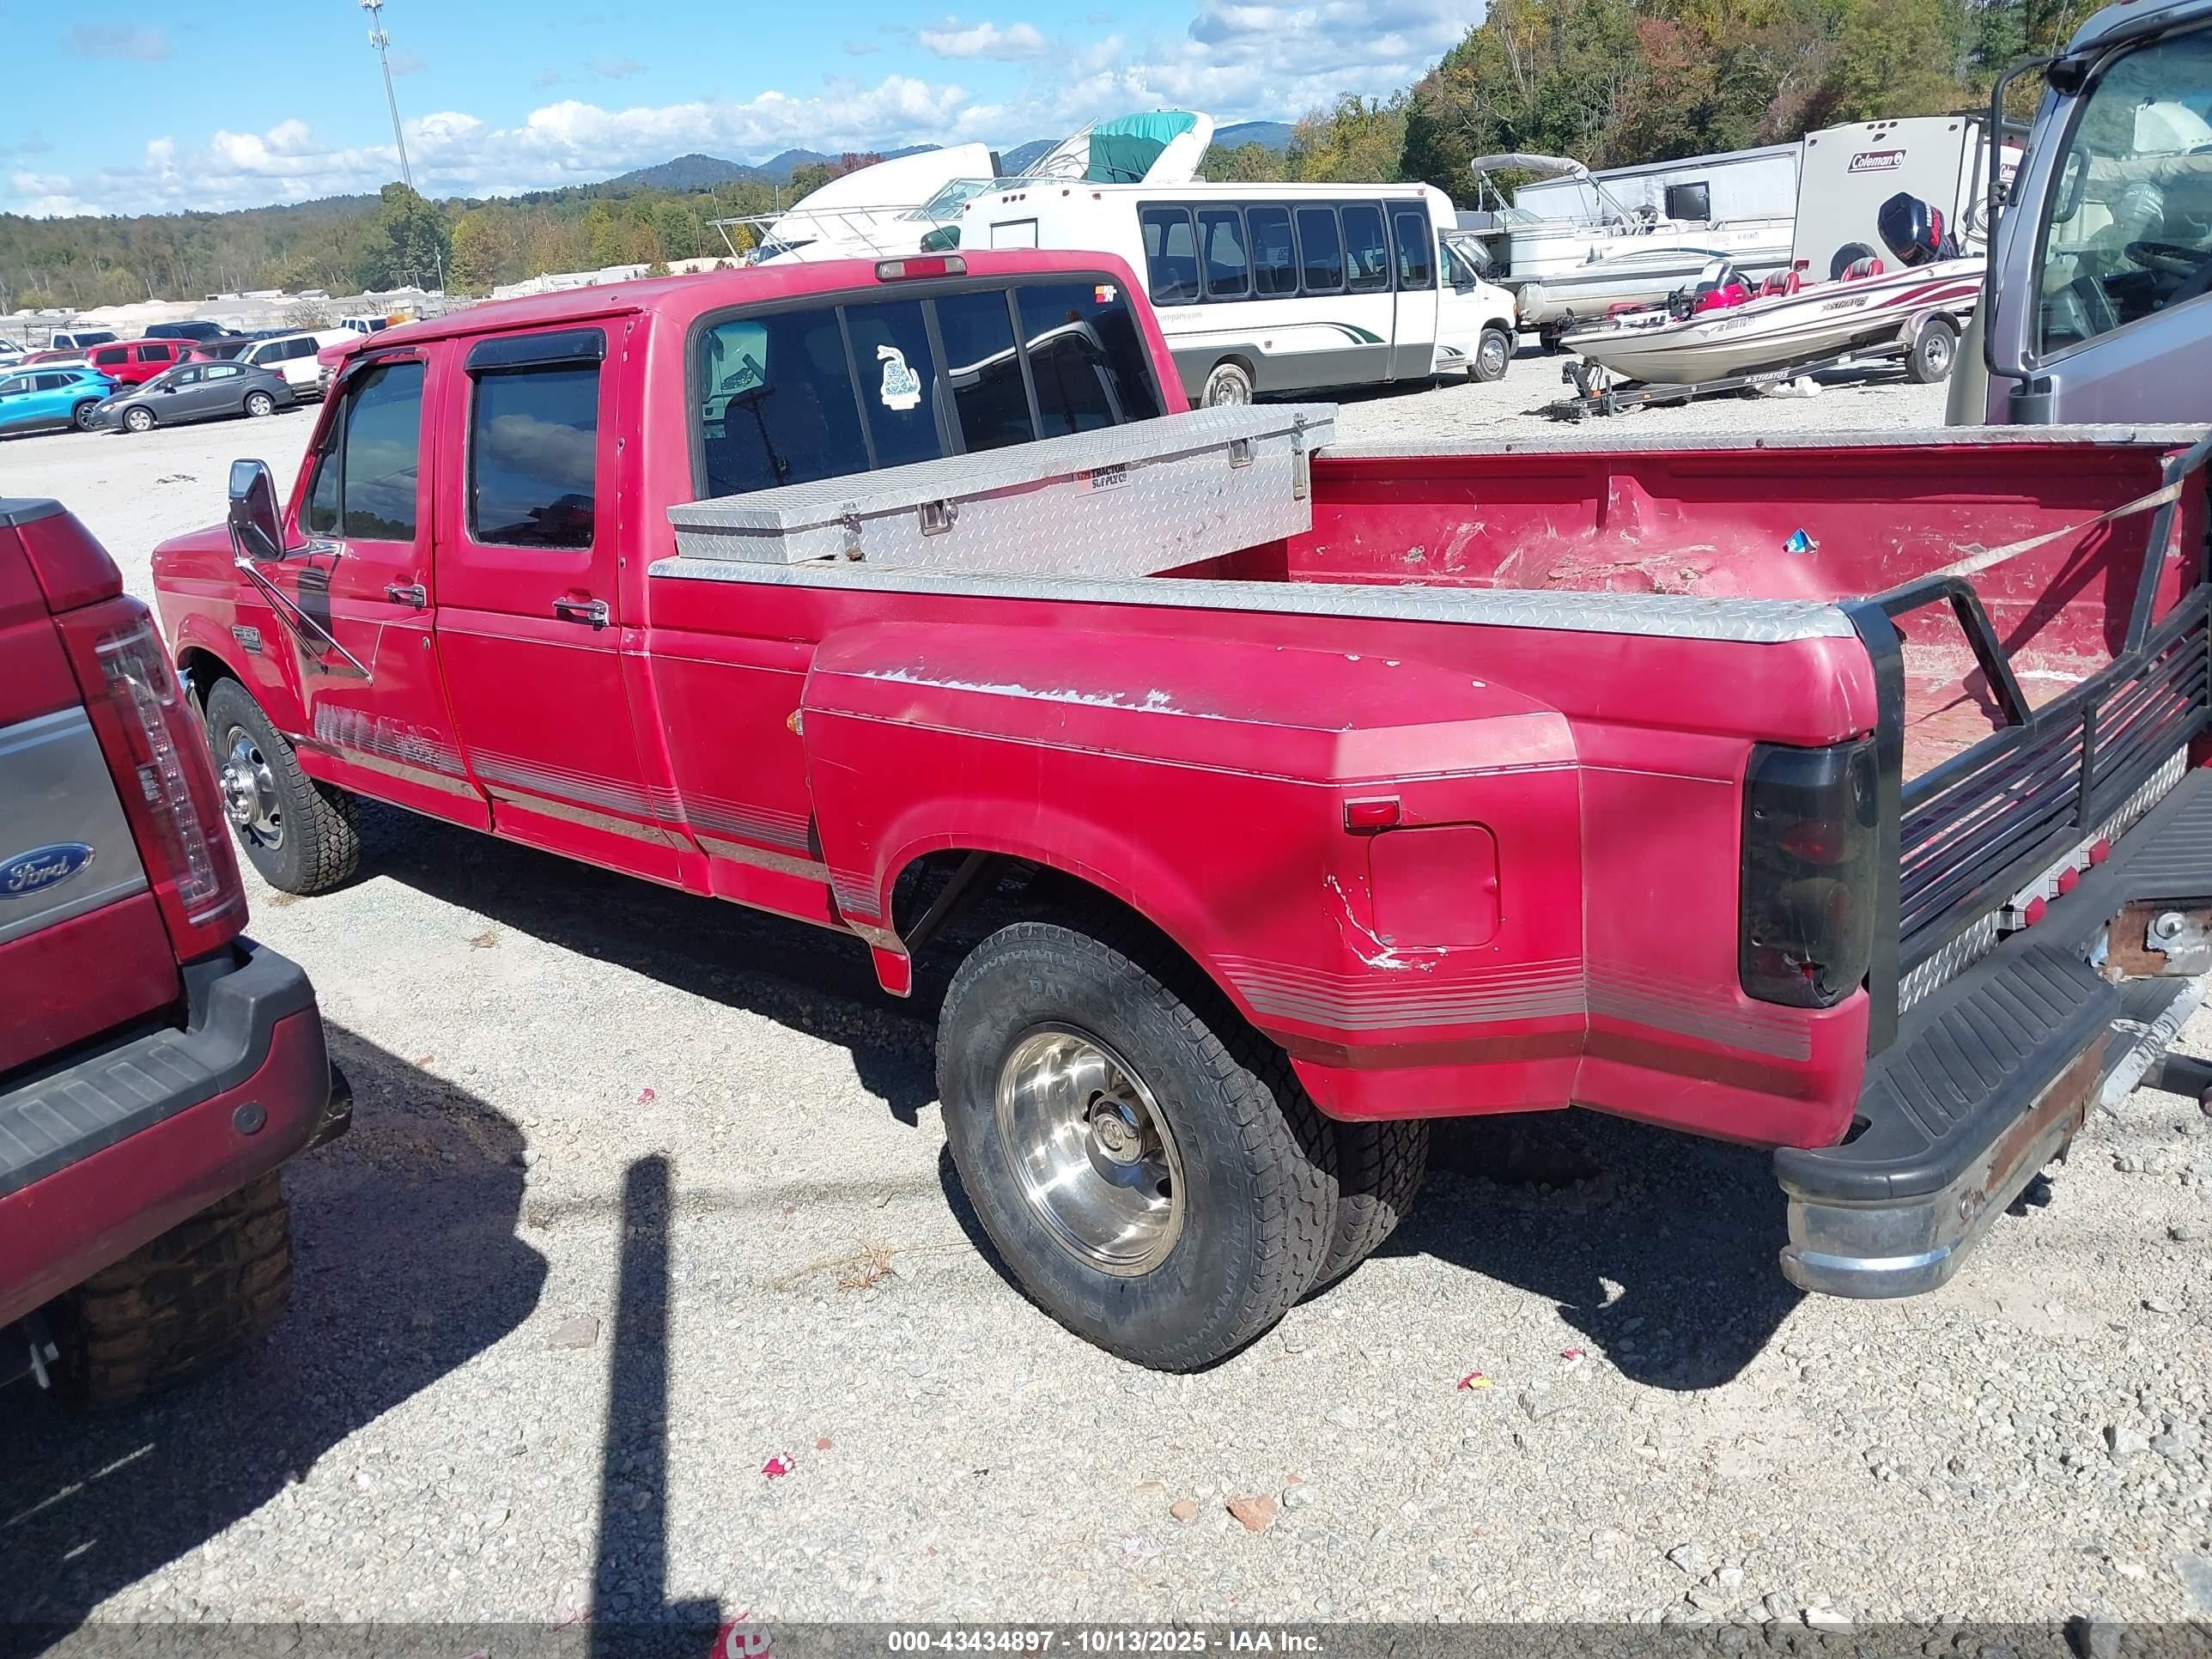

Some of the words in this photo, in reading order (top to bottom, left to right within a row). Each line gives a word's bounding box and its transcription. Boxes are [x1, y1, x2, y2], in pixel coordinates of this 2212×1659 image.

[1851, 154, 1894, 169] Coleman
[1091, 463, 1127, 478] TRACTOR
[8, 855, 70, 890] Ford
